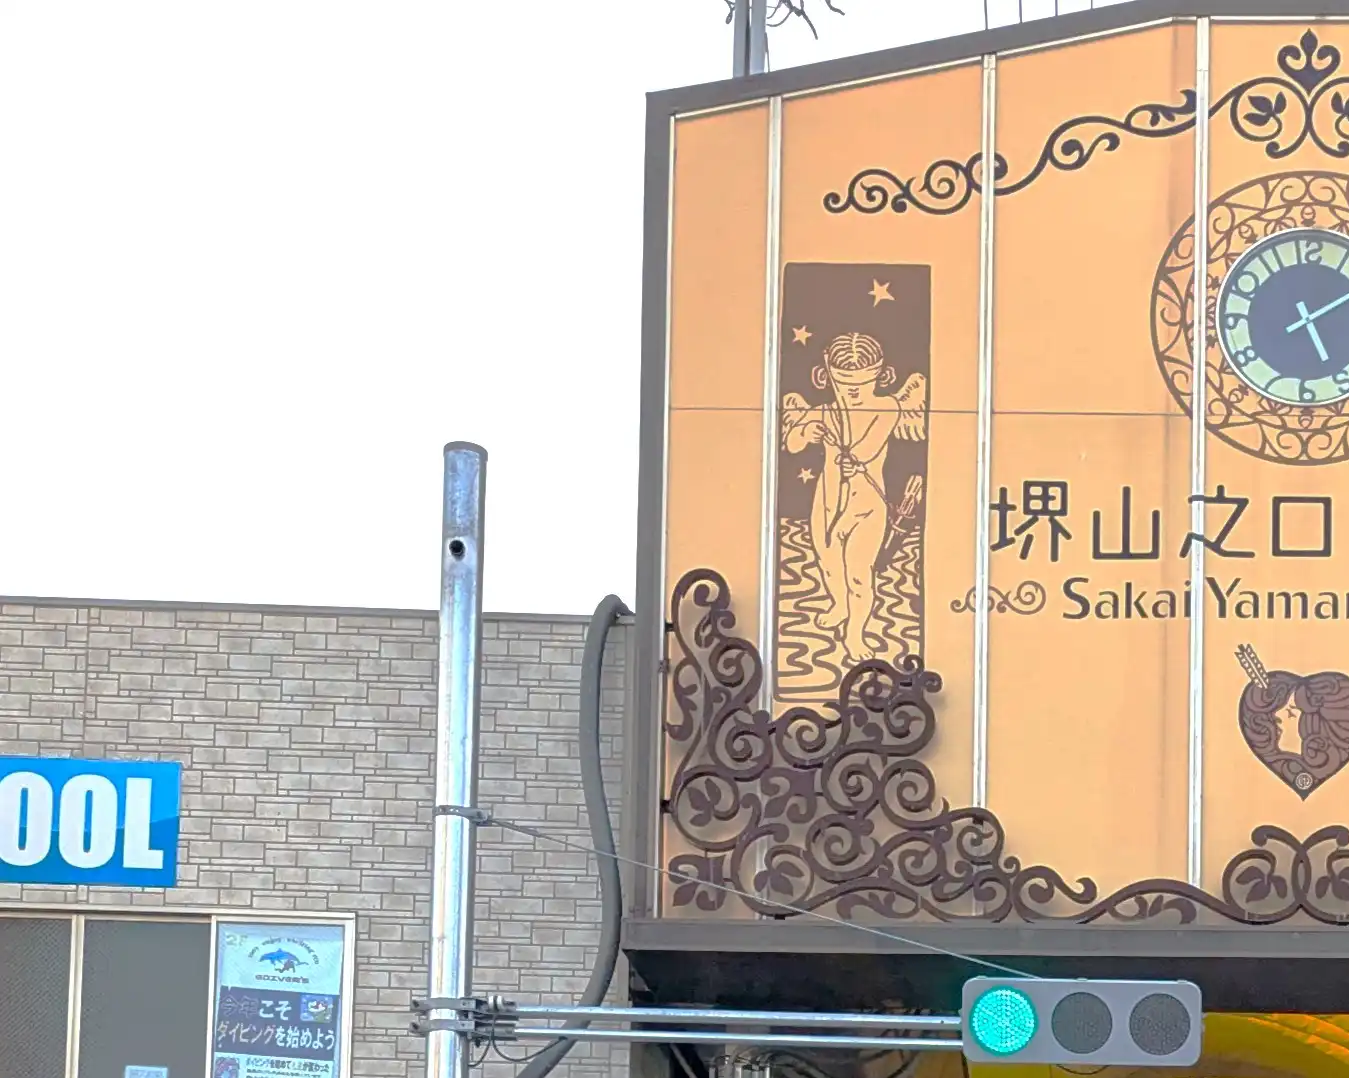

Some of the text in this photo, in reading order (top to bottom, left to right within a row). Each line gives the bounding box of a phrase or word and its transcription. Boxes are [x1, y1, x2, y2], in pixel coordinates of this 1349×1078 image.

[1062, 577, 1192, 620] Sakai
[0, 771, 164, 869] OOL
[217, 1021, 336, 1050] ダイビングを始めよう
